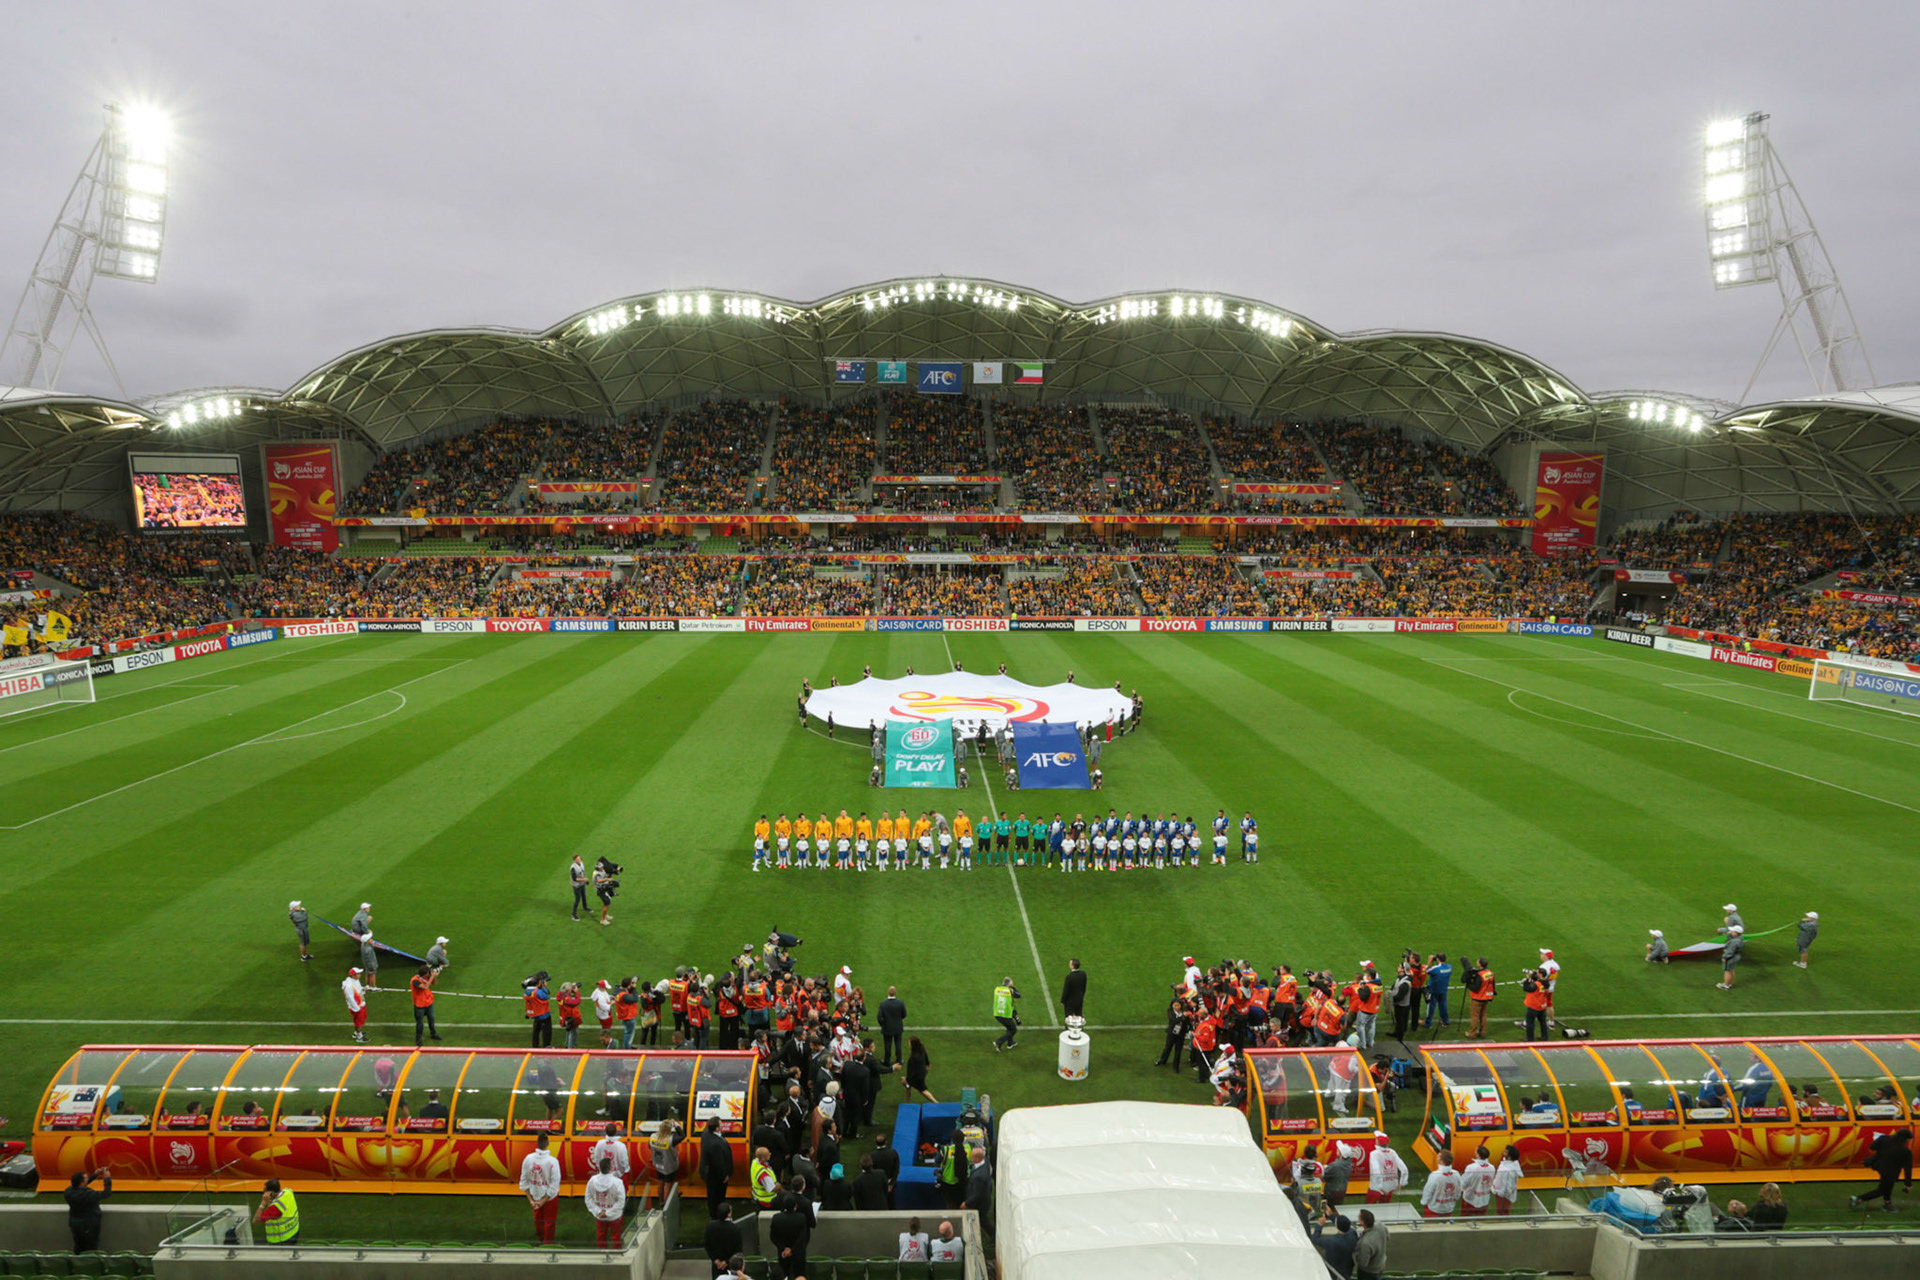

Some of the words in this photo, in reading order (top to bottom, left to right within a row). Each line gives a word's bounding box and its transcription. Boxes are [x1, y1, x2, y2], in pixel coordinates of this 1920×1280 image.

[923, 371, 956, 385] AFC
[288, 622, 356, 636] TOSHIBA
[393, 622, 421, 630] MINOLTA
[434, 622, 472, 632] EPSON
[492, 621, 543, 631] TOYOTA
[555, 621, 609, 631] SAMSUNG
[618, 621, 649, 630] KIRIN
[649, 621, 675, 630] BEER
[681, 622, 699, 630] Qatar
[748, 620, 765, 631] Fly
[766, 620, 808, 630] Emirates
[811, 620, 855, 630] Continental
[877, 620, 914, 630] SAISON
[915, 620, 942, 630] CARD
[945, 620, 1007, 630] TOSHIBA
[1088, 620, 1127, 630] EPSON
[1147, 620, 1198, 630] TOYOTA
[1210, 621, 1263, 630] SAMSUNG
[1272, 621, 1301, 630] KIRIN
[1303, 621, 1327, 630] BEER
[1398, 621, 1414, 632] Fly
[1415, 621, 1455, 631] Emirates
[1457, 621, 1498, 631] Continental
[1520, 622, 1559, 633] SAISON
[1561, 625, 1592, 635] CARD
[230, 629, 273, 647] SAMSUNG
[1607, 629, 1631, 643] KIRIN
[1630, 634, 1652, 646] BEER
[180, 639, 222, 658] TOYOTA
[126, 651, 164, 669] EPSON
[1713, 648, 1729, 663] Fly
[1730, 651, 1773, 669] Emirates
[1777, 660, 1827, 678] Continenal
[1855, 675, 1905, 693] SAISON
[911, 730, 929, 740] 60
[1023, 752, 1074, 768] AFC
[895, 759, 946, 772] PLAY!
